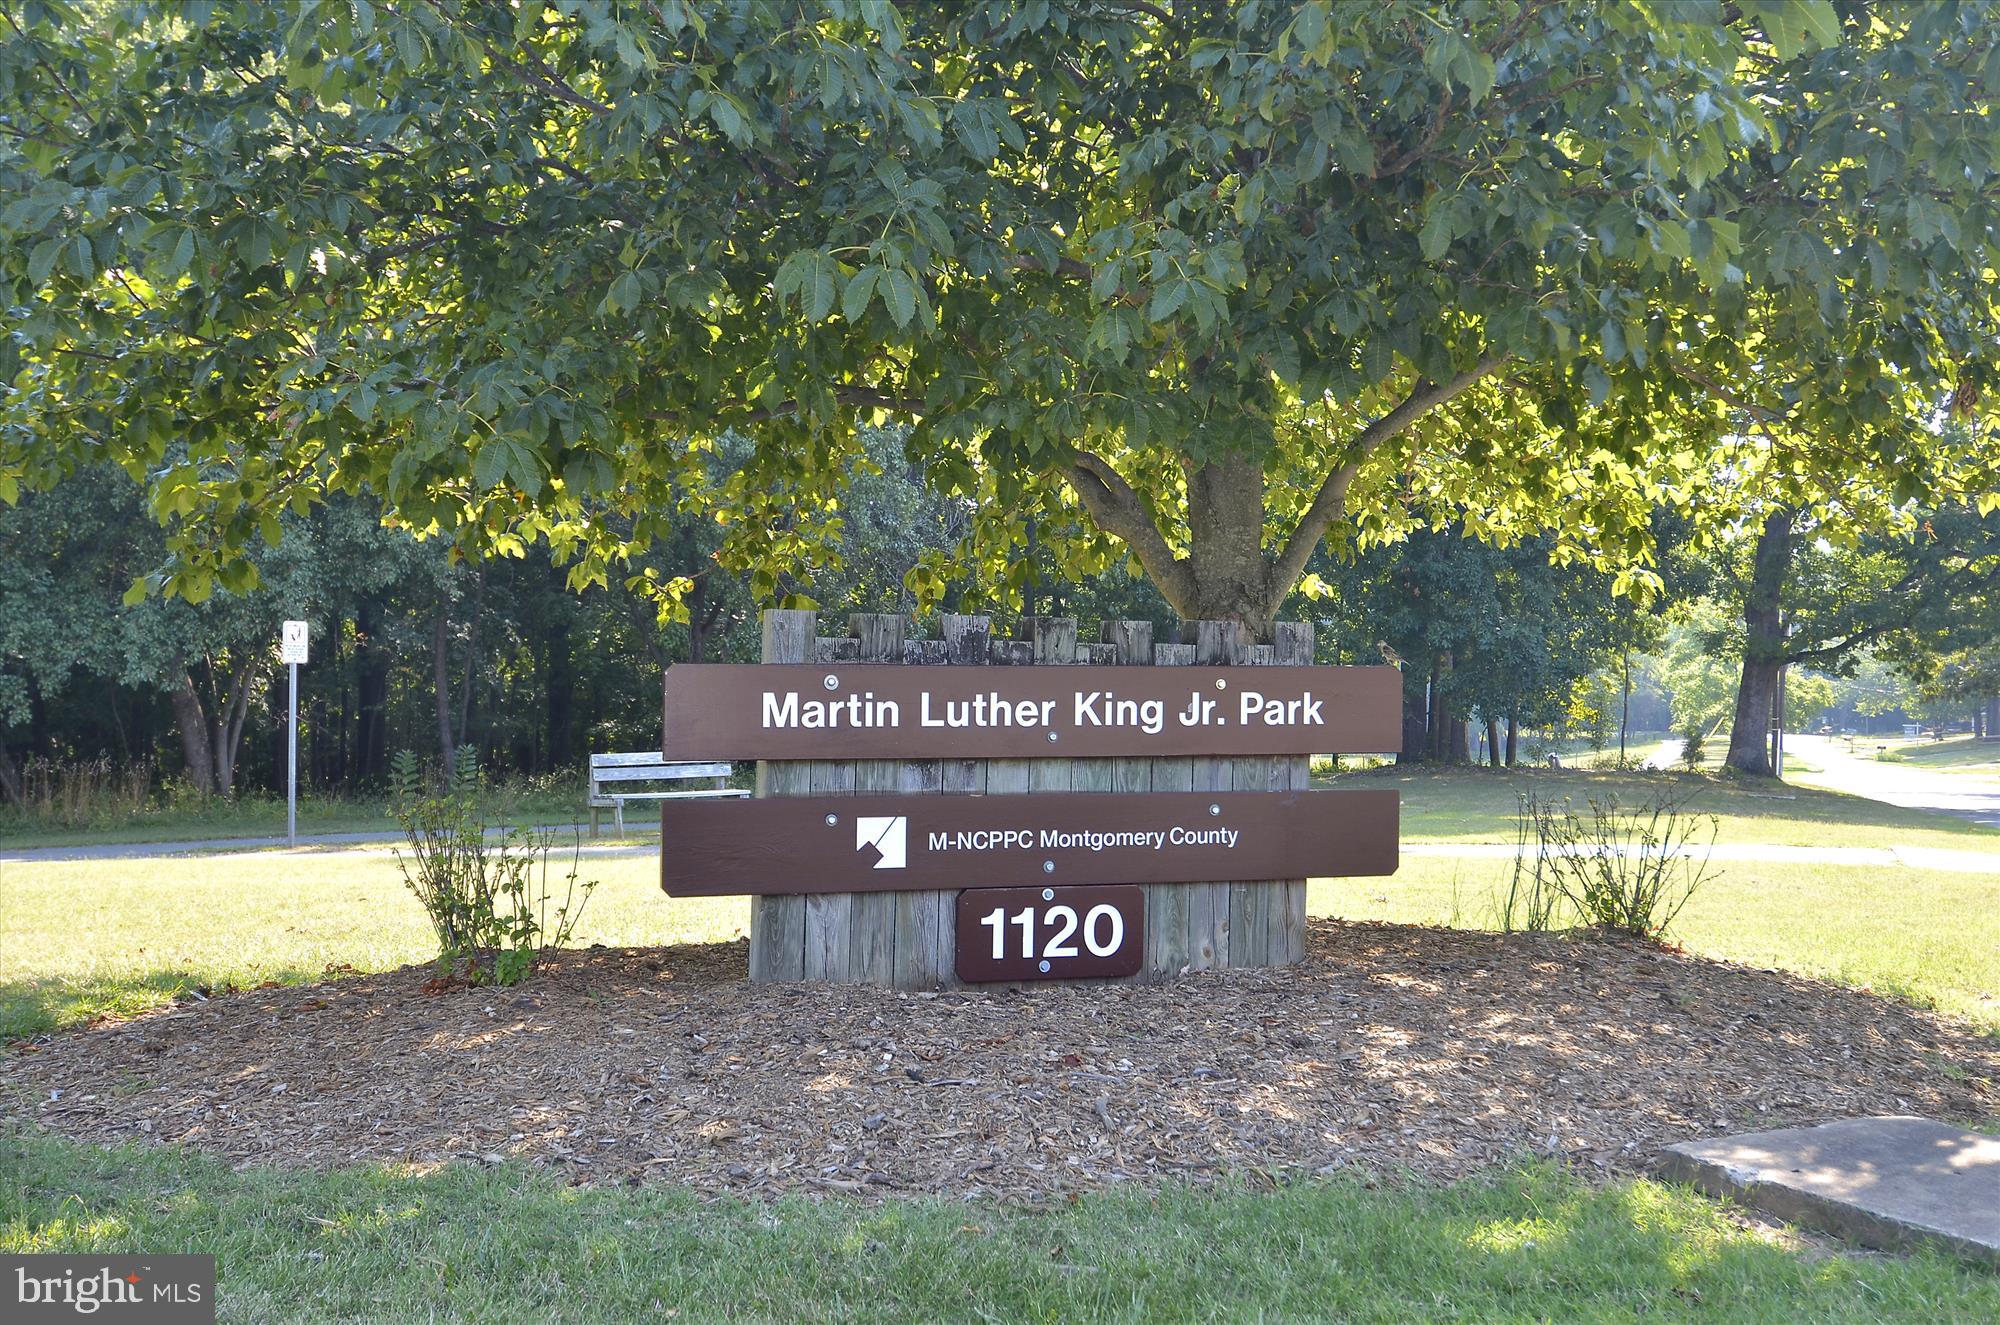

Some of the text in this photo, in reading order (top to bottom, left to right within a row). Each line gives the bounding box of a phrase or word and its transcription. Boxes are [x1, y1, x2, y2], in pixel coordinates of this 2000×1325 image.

[762, 691, 1325, 735] Martin Luther King Jr. Park
[928, 826, 1239, 851] M-NCPPC Montgomery County
[980, 904, 1124, 960] 1120
